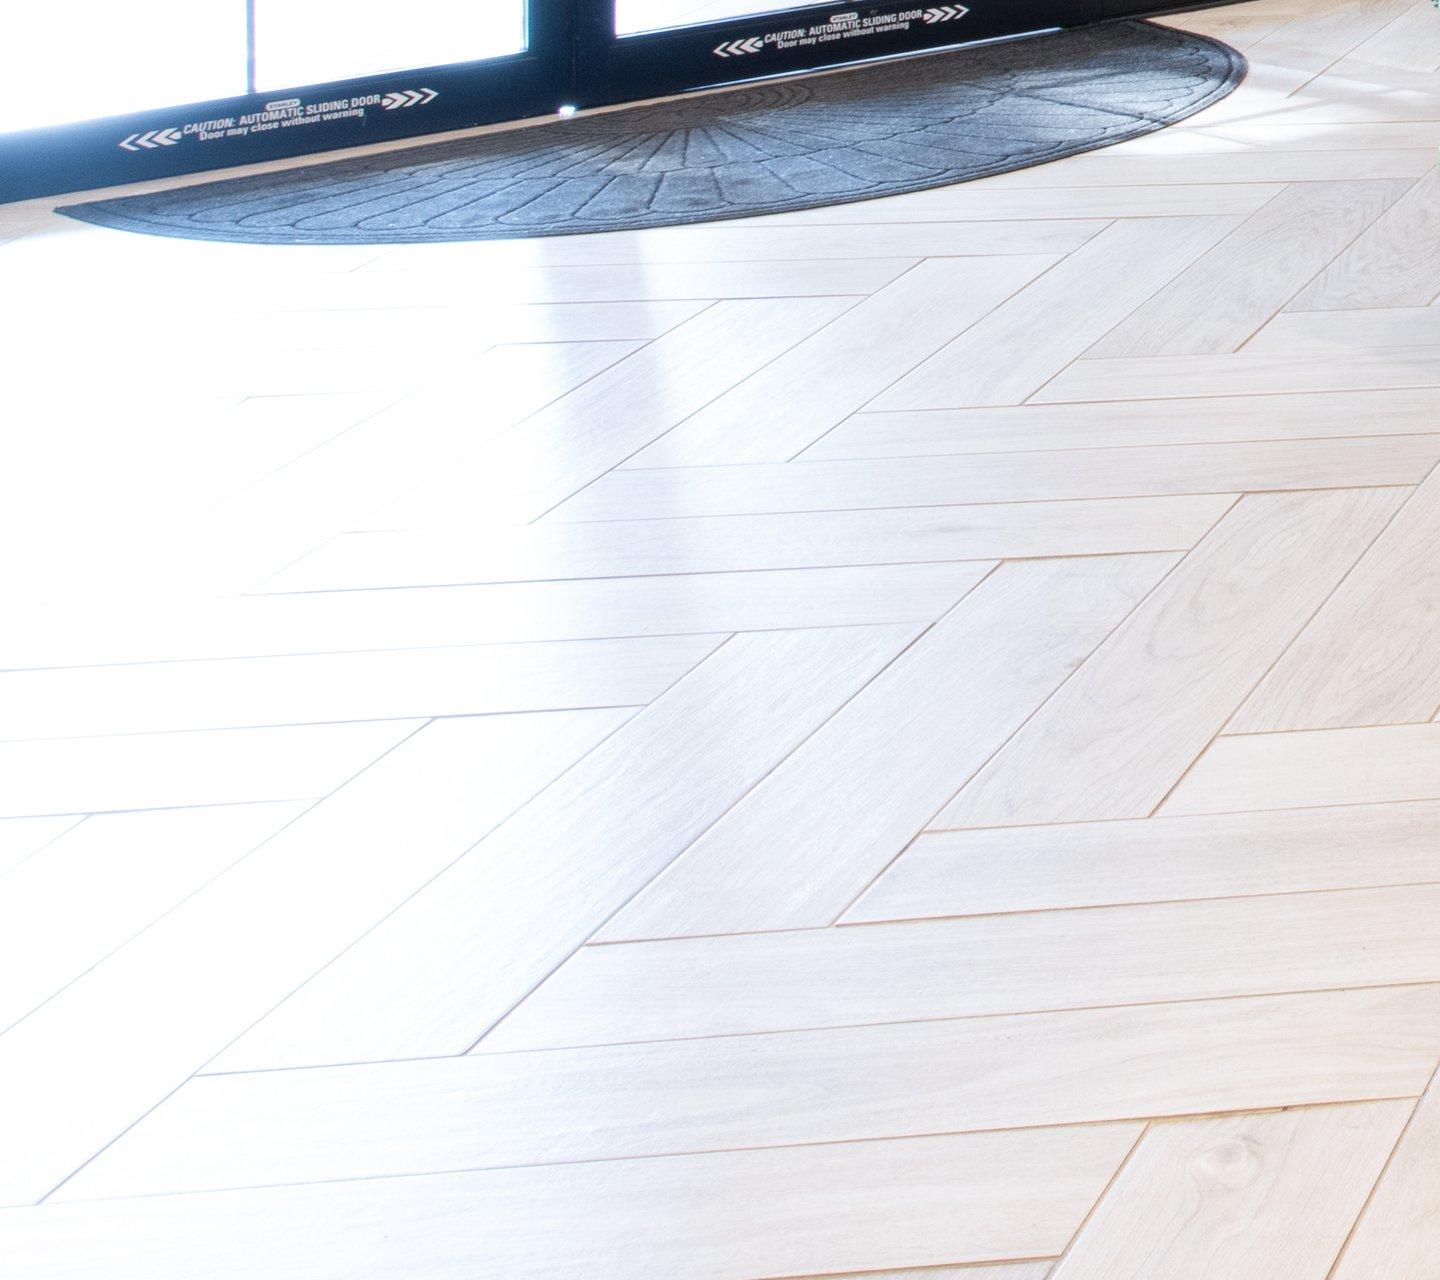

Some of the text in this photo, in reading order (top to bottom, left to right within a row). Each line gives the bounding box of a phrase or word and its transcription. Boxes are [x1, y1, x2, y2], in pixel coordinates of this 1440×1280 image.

[764, 10, 922, 43] CAUTION: AUTOMATIC SLIDING DOOR
[777, 21, 910, 49] Door may close without warning
[183, 94, 381, 135] CAUTION: AUTOMATIC SLIDING DOOR
[199, 107, 364, 141] Door may close without warning
